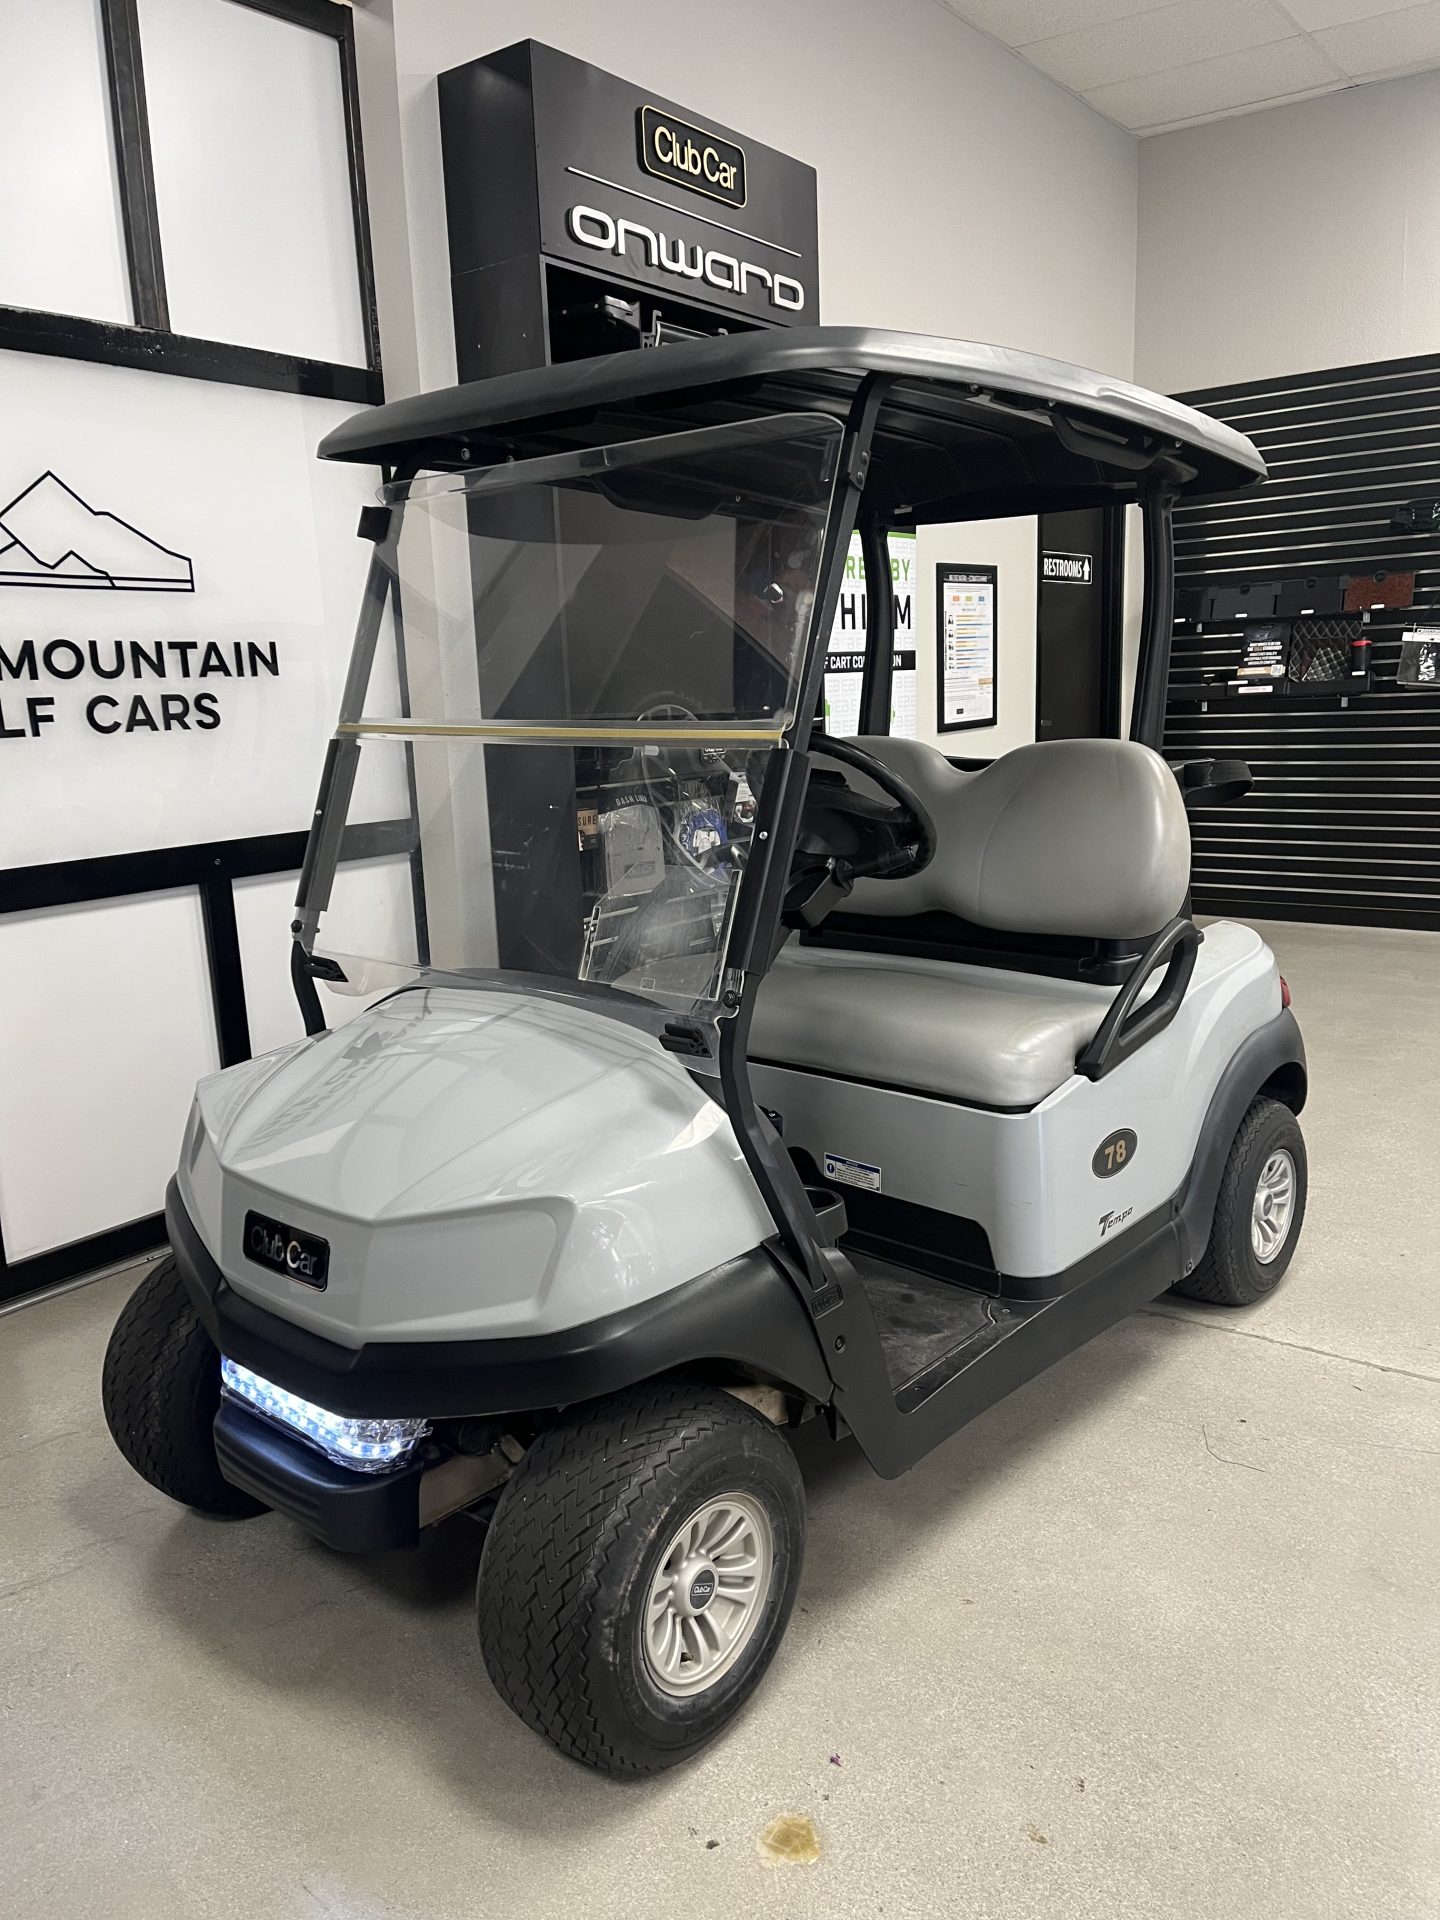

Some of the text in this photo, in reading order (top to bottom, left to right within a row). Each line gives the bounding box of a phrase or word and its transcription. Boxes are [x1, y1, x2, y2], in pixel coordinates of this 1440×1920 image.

[654, 126, 737, 190] Club Car
[1043, 558, 1083, 578] RESTROOMS
[0, 639, 280, 681] MOUNTAIN
[830, 656, 851, 669] CART
[86, 693, 221, 734] CARS
[615, 795, 634, 806] DASH
[1104, 1139, 1127, 1170] 78
[1098, 1206, 1133, 1237] Tempo
[251, 1226, 318, 1275] Club Car
